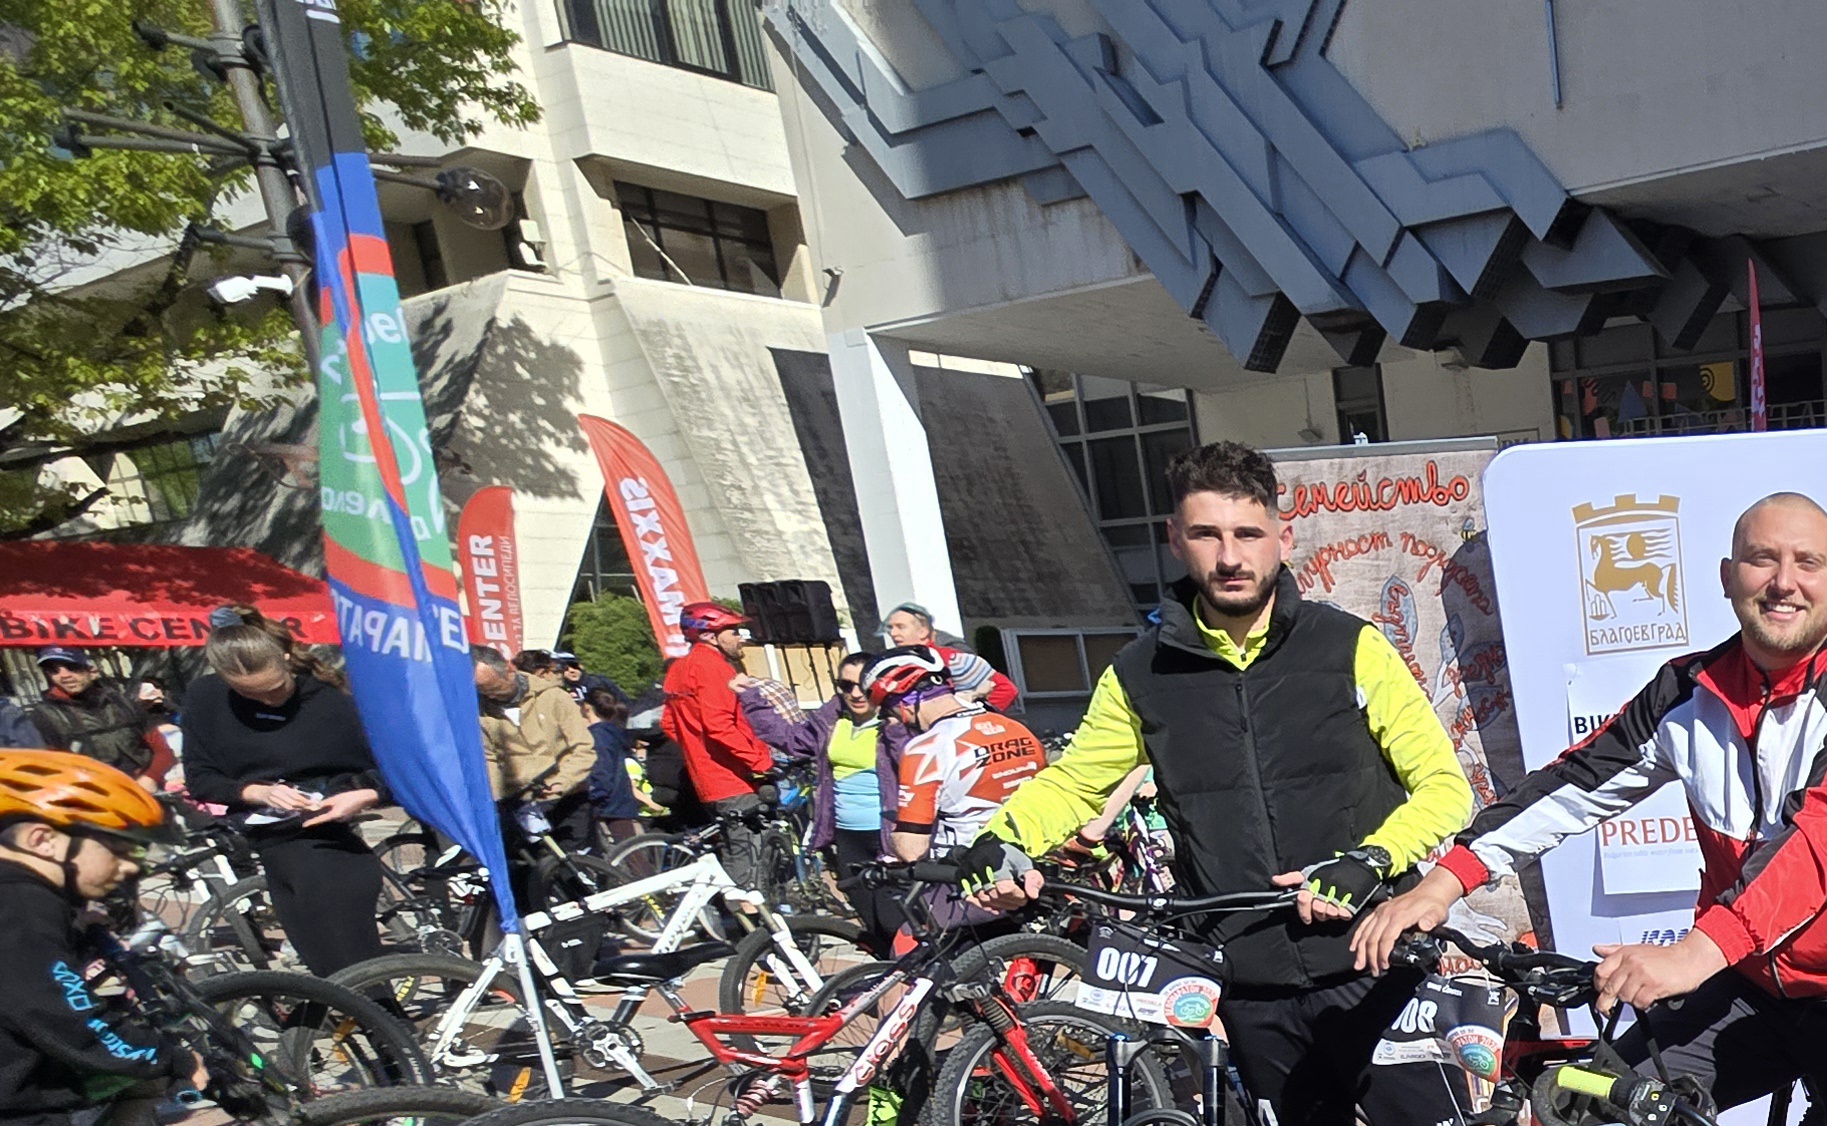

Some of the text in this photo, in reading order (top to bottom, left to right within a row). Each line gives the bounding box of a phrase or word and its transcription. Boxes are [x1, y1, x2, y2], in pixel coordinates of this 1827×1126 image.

[1298, 531, 1394, 594] игурност
[1590, 622, 1686, 646] БЛАГОЕВГРАД
[1574, 713, 1616, 734] BIK
[974, 736, 1033, 758] DRAG
[976, 748, 1036, 769] ZONE
[1601, 816, 1698, 847] PREDE
